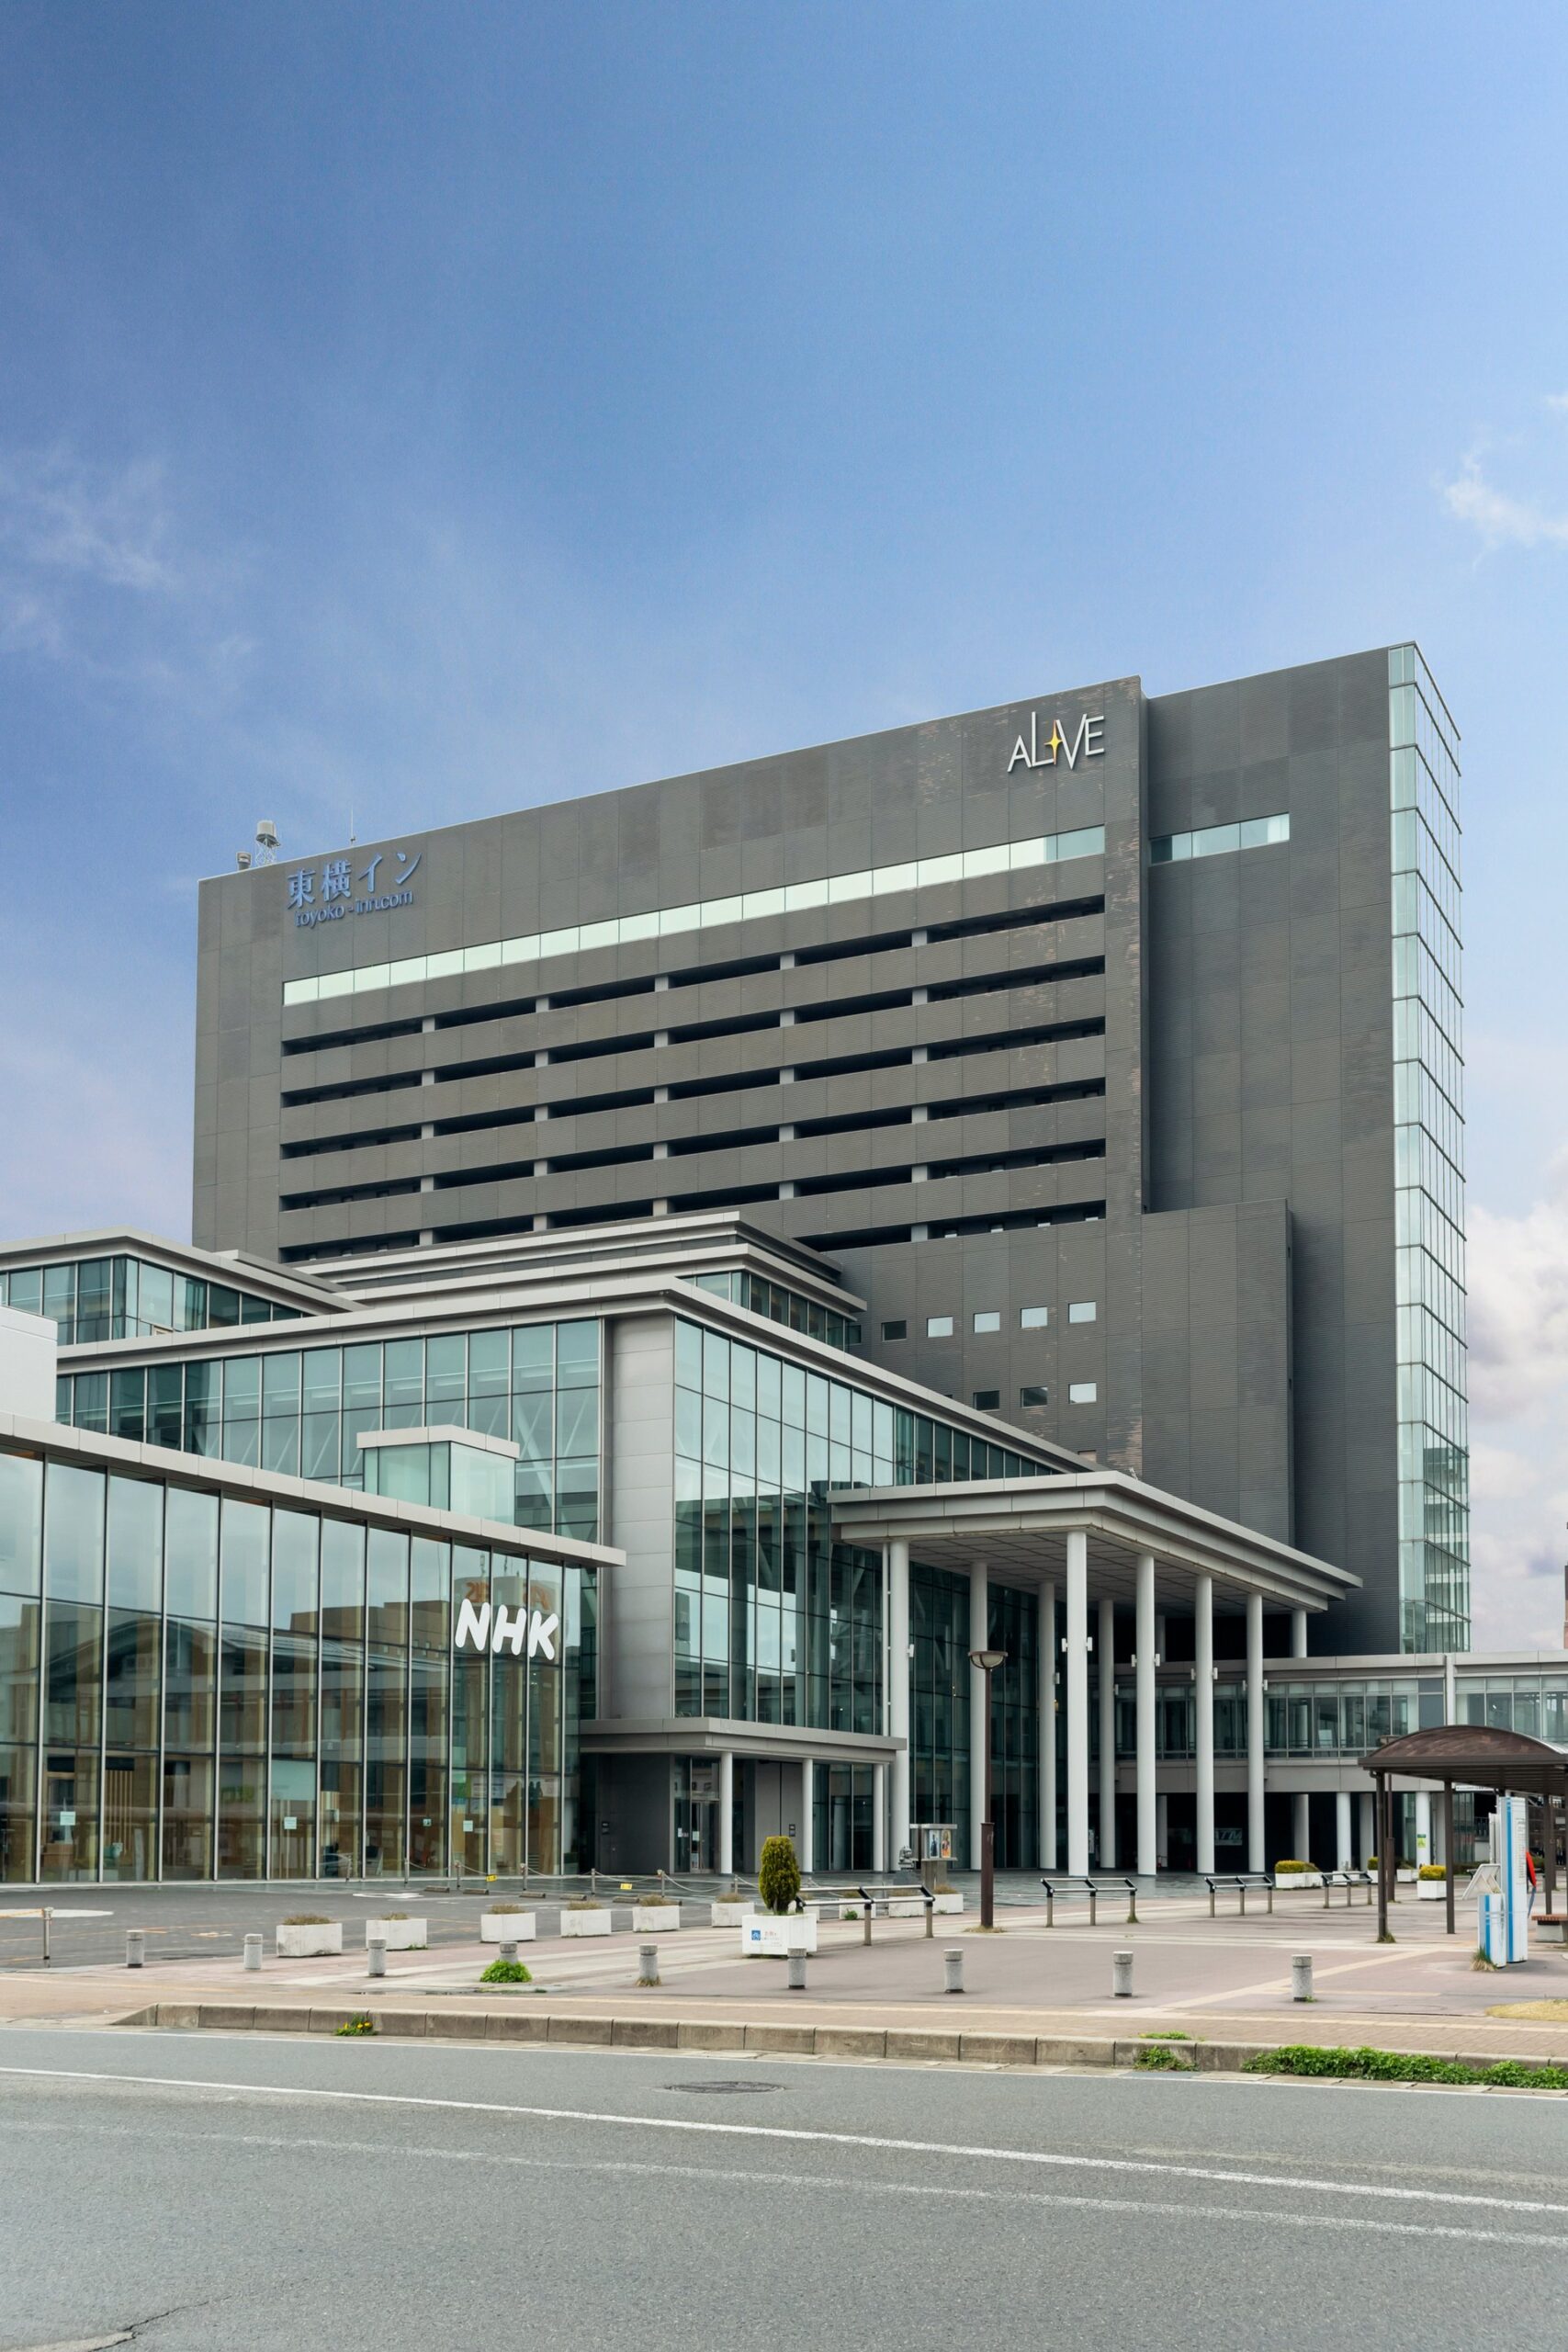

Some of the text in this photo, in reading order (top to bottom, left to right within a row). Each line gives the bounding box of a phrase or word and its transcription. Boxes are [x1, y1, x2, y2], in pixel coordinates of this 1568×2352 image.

[288, 852, 423, 910] 東横イン
[455, 1599, 559, 1660] NHK
